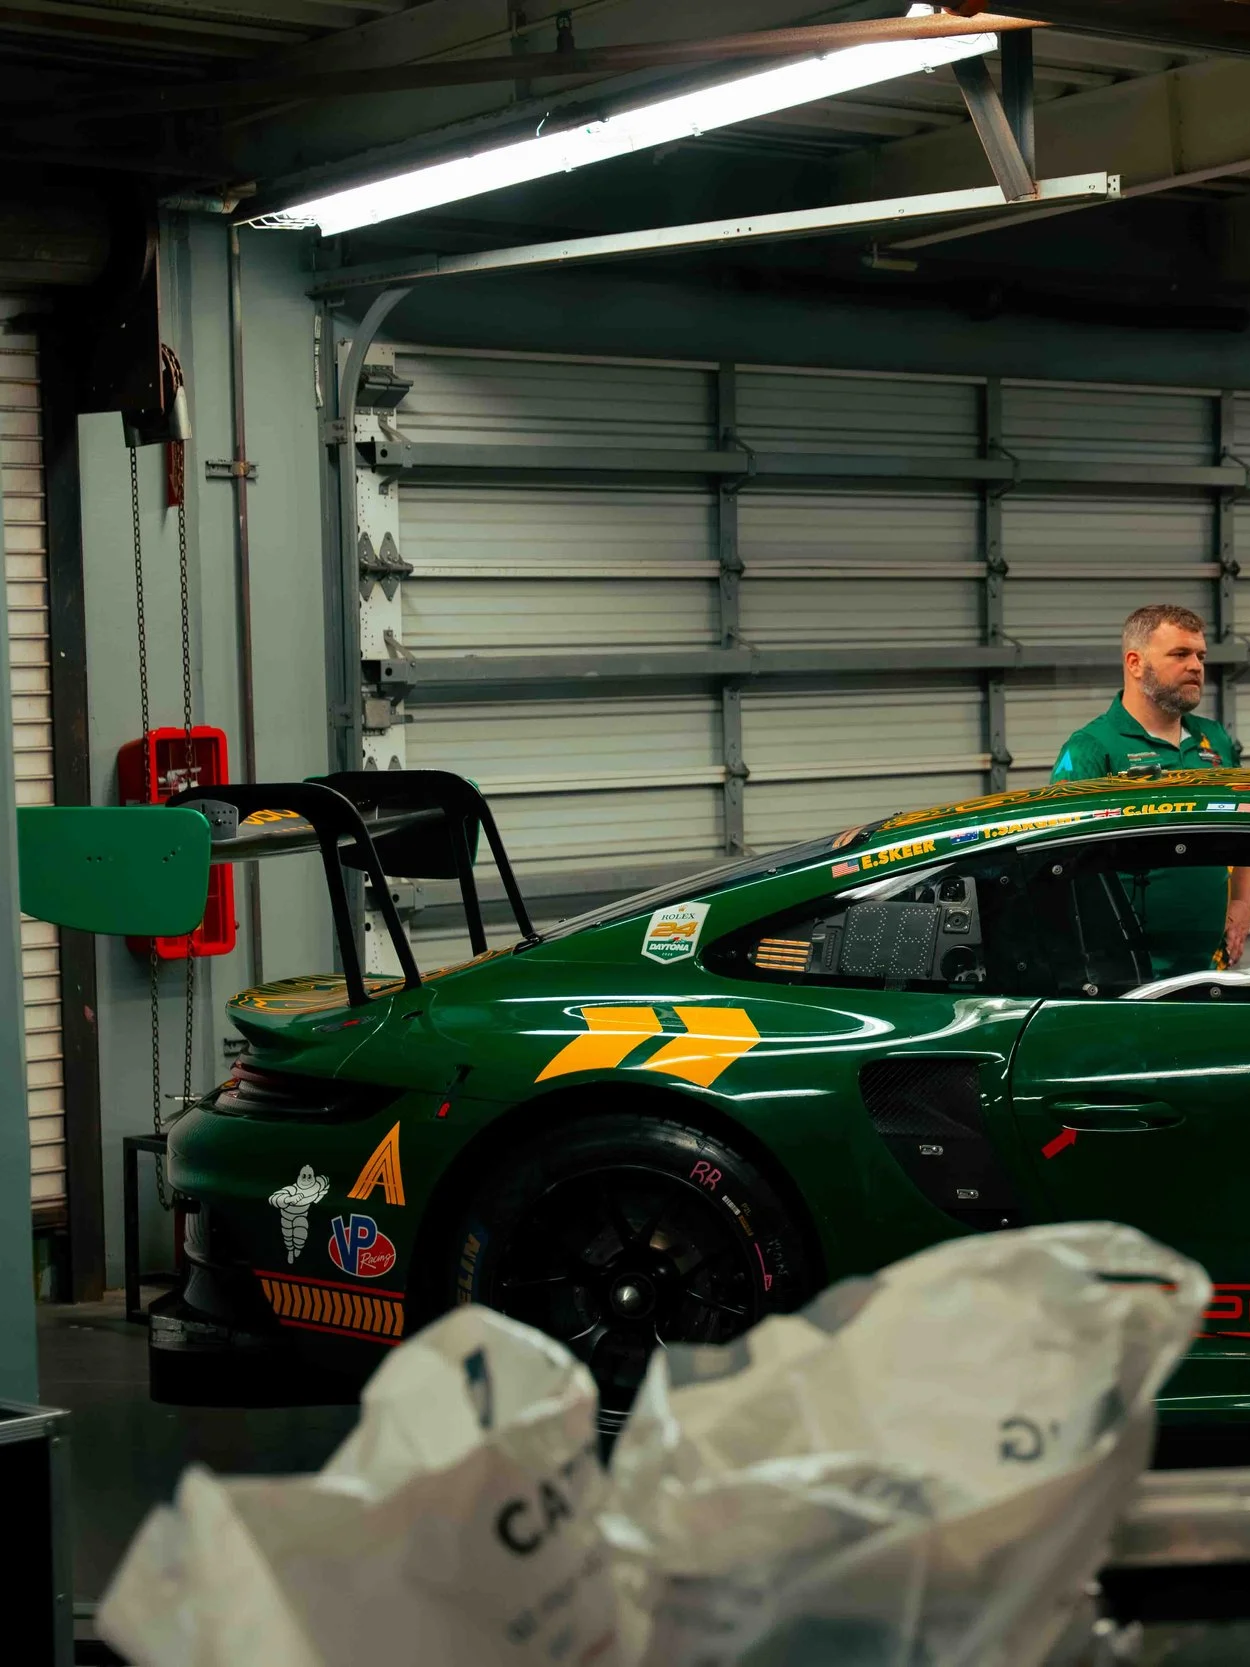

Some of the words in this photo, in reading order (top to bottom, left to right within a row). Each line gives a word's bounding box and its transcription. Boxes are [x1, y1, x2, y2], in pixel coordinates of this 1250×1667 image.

[1123, 802, 1196, 817] C.ILOTT
[861, 839, 936, 870] E.SKEER
[650, 922, 698, 937] 24
[649, 943, 689, 951] DAYTONA
[331, 1213, 378, 1275] VP
[360, 1252, 395, 1269] Racing
